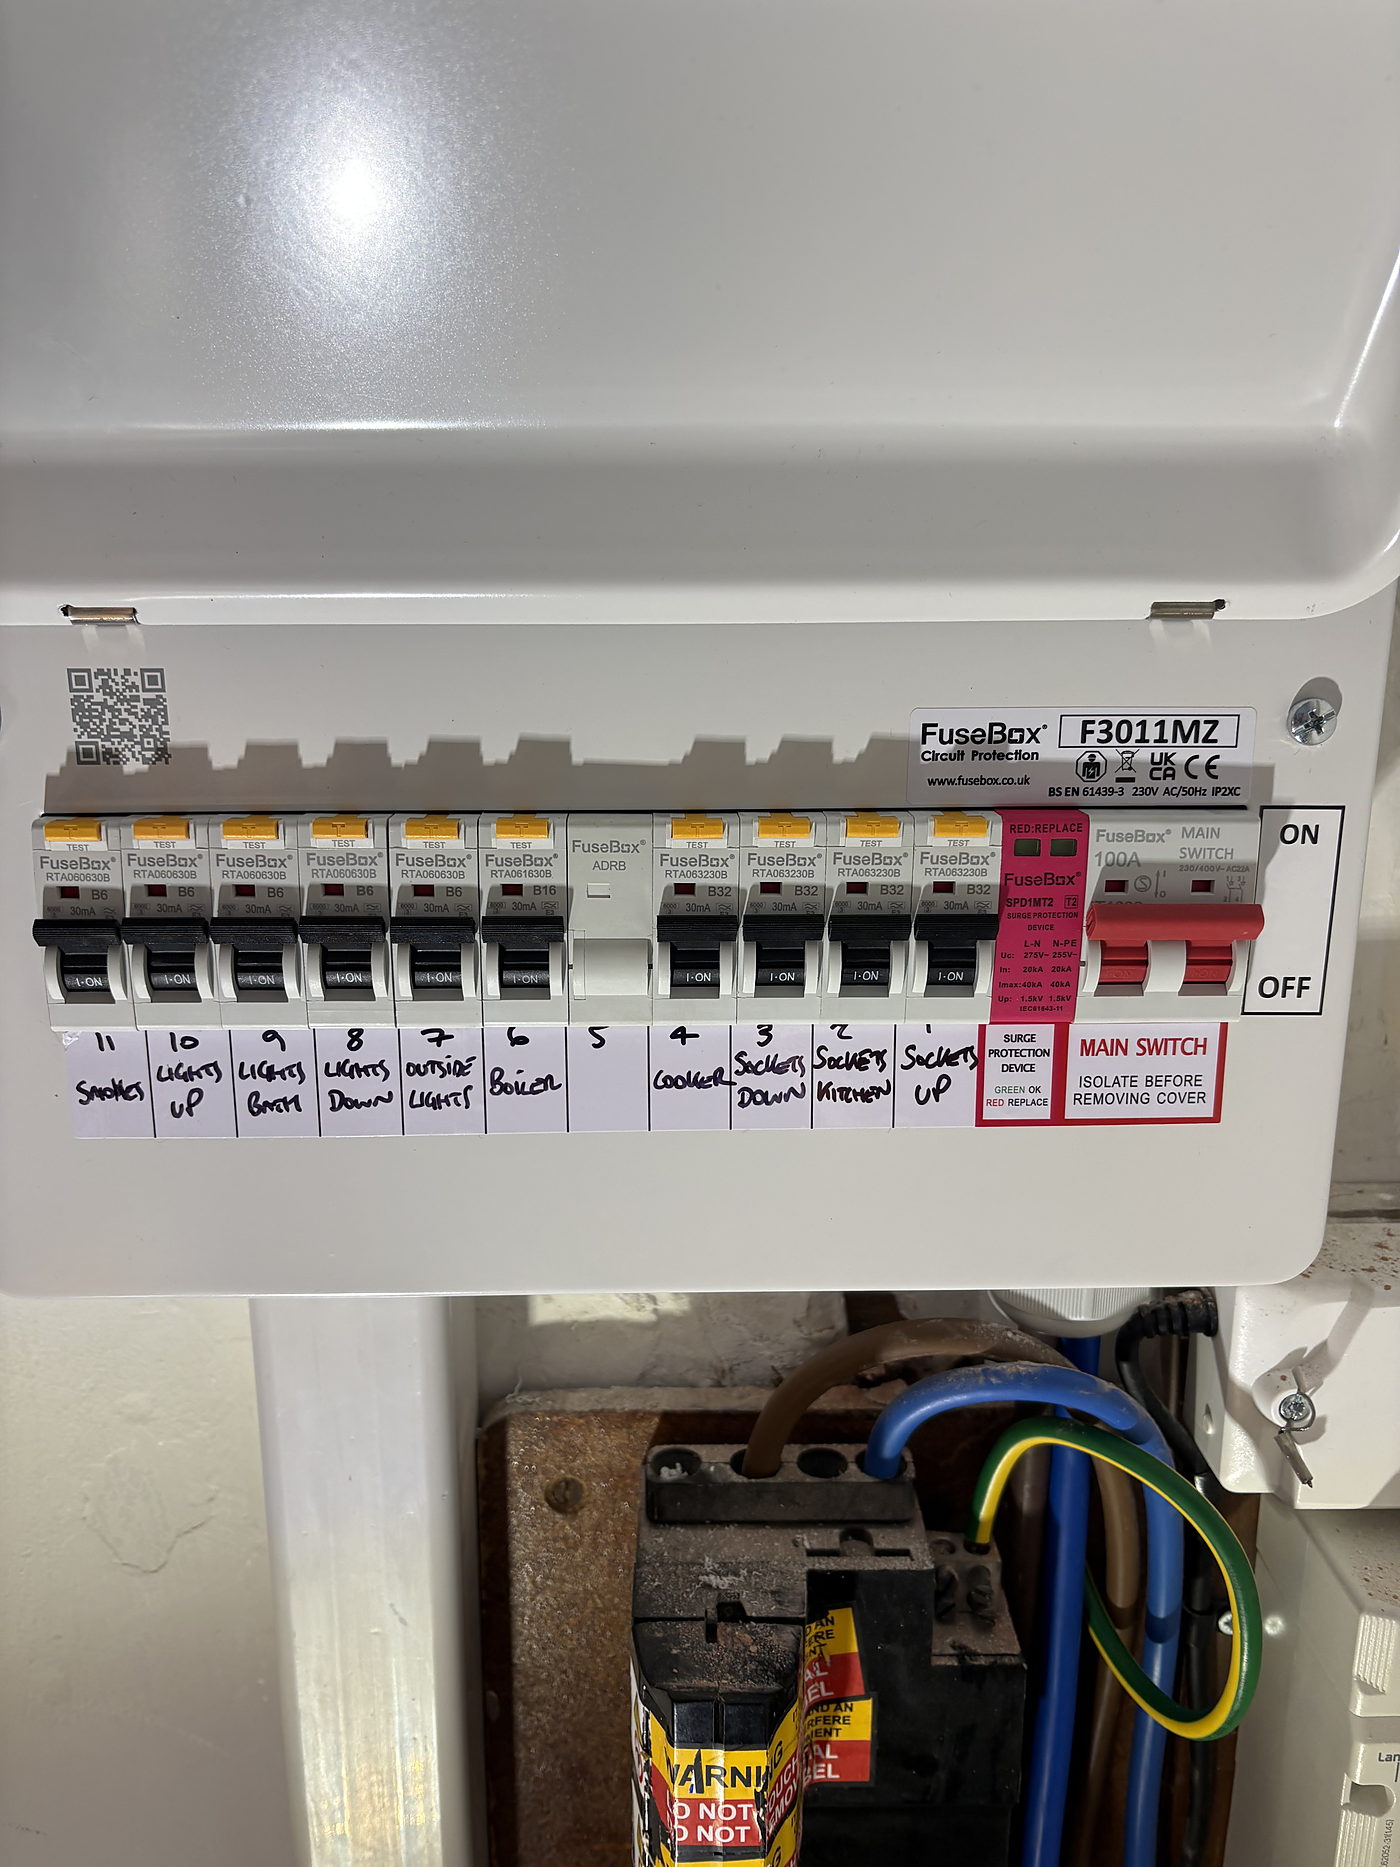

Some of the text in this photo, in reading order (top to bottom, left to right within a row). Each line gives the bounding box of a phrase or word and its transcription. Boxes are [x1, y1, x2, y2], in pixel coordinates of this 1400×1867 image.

[1080, 719, 1219, 744] F3011MZ
[921, 750, 1039, 762] Circuit Protection
[1150, 752, 1175, 766] UK
[1184, 754, 1220, 780] CE
[1149, 767, 1175, 781] CA
[927, 774, 1030, 787] www.fusebox.co.uk
[1048, 785, 1241, 798] BS EN 61439-3 230V AC/50Hz IP2XC
[1181, 827, 1220, 839] MAIN
[1279, 824, 1319, 845] ON
[1179, 847, 1233, 860] SWITCH
[1094, 852, 1141, 867] 100A
[592, 861, 626, 870] ADRB
[133, 870, 197, 879] RTA060630B
[222, 870, 286, 880] RTA060630B
[311, 869, 376, 878] RTA060630B
[401, 870, 465, 880] RTA060630B
[490, 869, 552, 878] RTA061630B
[665, 870, 728, 879] RTA063230B
[752, 869, 815, 878] RTA063230B
[838, 869, 900, 877] RTA063230B
[924, 868, 987, 876] RTA063230B
[46, 873, 110, 882] RTA060630B
[92, 890, 108, 900] B6
[178, 887, 195, 897] B6
[268, 887, 284, 898] B6
[357, 885, 374, 896] B6
[446, 886, 463, 897] B6
[534, 885, 556, 895] B16
[708, 886, 732, 896] B32
[794, 886, 818, 896] B32
[880, 885, 904, 895] B32
[967, 885, 990, 895] B32
[512, 902, 537, 911] 30mA
[772, 902, 797, 911] 30mA
[858, 901, 882, 910] 30mA
[944, 901, 968, 910] 30mA
[1006, 898, 1053, 907] SPD1MT2
[1066, 898, 1077, 906] T2
[70, 906, 96, 916] 30mA
[157, 903, 182, 913] 30mA
[245, 904, 271, 914] 30mA
[334, 903, 359, 913] 30mA
[424, 903, 449, 913] 30mA
[686, 903, 711, 912] 30mA
[1258, 976, 1311, 999] OFF
[670, 1026, 699, 1045] 4
[756, 1024, 773, 1047] 3
[830, 1024, 852, 1039] 2
[95, 1032, 115, 1051] 11
[170, 1032, 199, 1052] 10
[262, 1030, 286, 1051] 9
[346, 1028, 364, 1051] 8
[421, 1028, 454, 1047] 7
[507, 1027, 530, 1047] 6
[588, 1026, 609, 1048] 5
[1003, 1034, 1036, 1043] SURGE
[1080, 1038, 1208, 1057] MAIN SWITCH
[988, 1048, 1050, 1058] PROTECTION
[1001, 1063, 1036, 1072] DEVICE
[1079, 1074, 1203, 1088] ISOLATE BEFORE
[915, 1074, 952, 1106] UP
[994, 1085, 1041, 1094] GREEN OK
[986, 1098, 1048, 1107] RED REPLACE
[1073, 1092, 1206, 1105] REMOVING COVER
[699, 1802, 754, 1821] NOT
[697, 1826, 750, 1842] NOT
